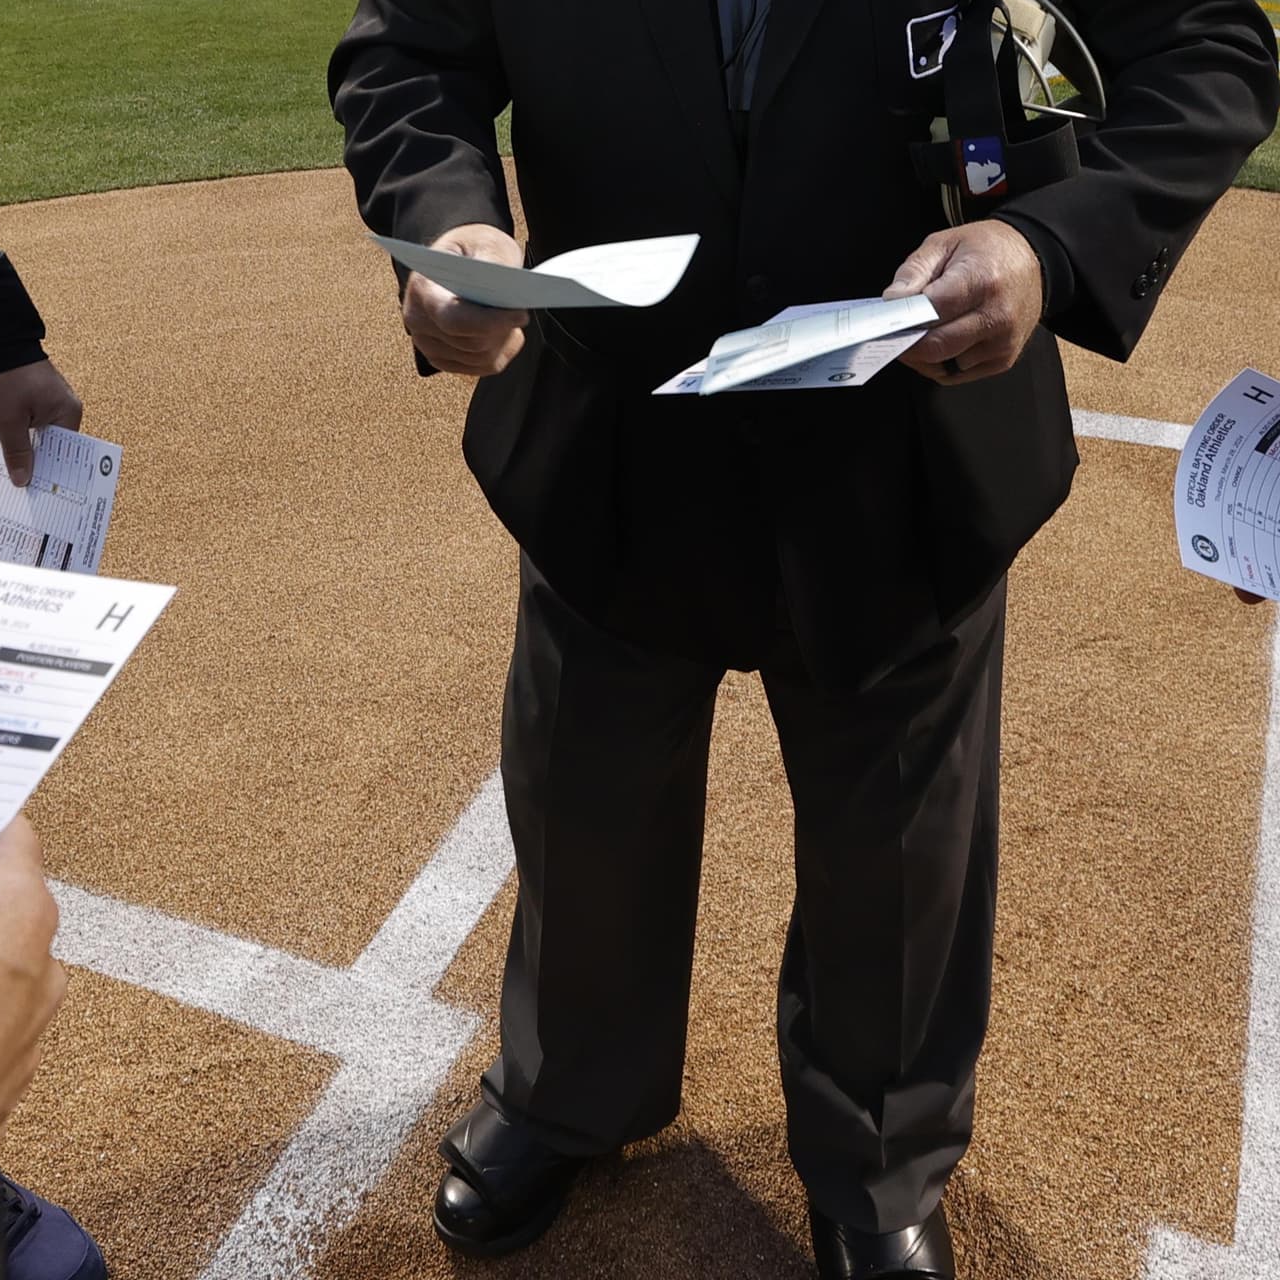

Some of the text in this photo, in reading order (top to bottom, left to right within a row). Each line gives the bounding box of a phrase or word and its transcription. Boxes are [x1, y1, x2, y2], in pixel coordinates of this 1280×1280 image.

[1243, 385, 1274, 405] H
[1187, 412, 1227, 506] OFFICIAL BATTING ORDER
[1195, 463, 1212, 508] Oakland
[1206, 418, 1236, 463] Athletics
[36, 584, 76, 601] ORDER
[95, 601, 135, 634] H
